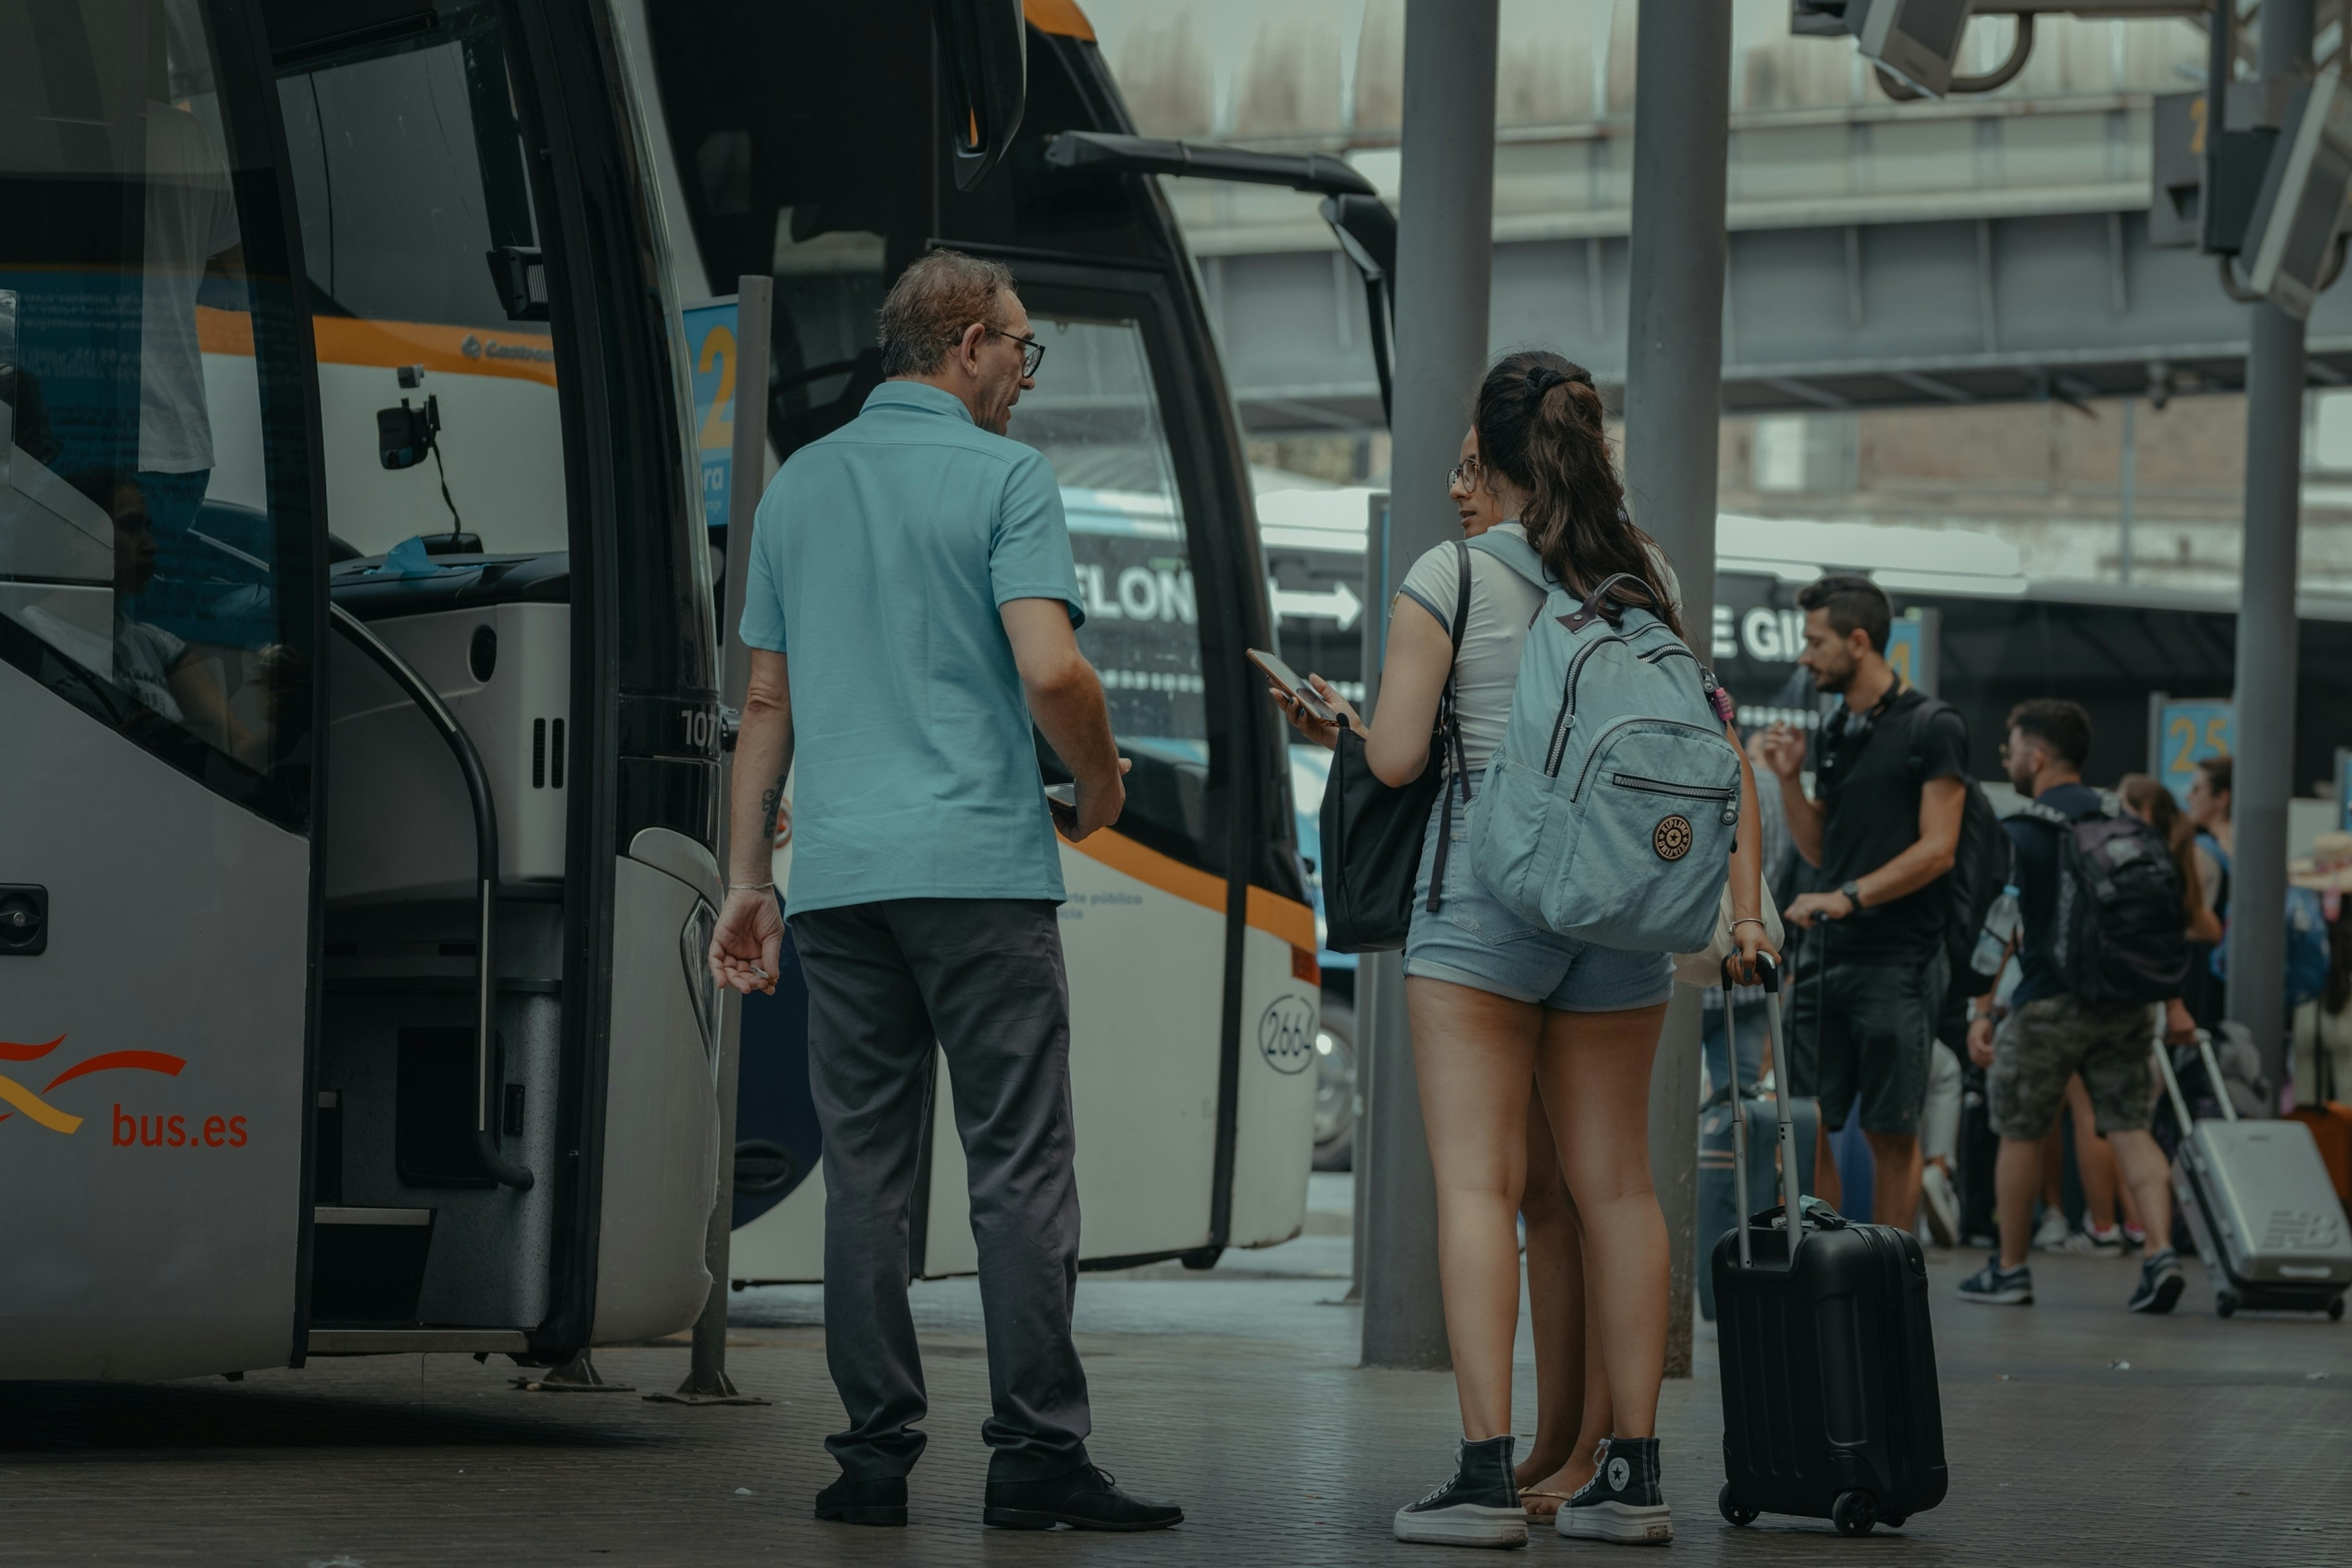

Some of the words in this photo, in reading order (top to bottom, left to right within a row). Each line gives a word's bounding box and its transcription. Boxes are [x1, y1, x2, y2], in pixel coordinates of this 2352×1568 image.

[687, 325, 737, 450] 2
[2169, 716, 2228, 772] 25
[1661, 819, 1689, 835] KIPLING
[112, 1104, 248, 1147] bus.es
